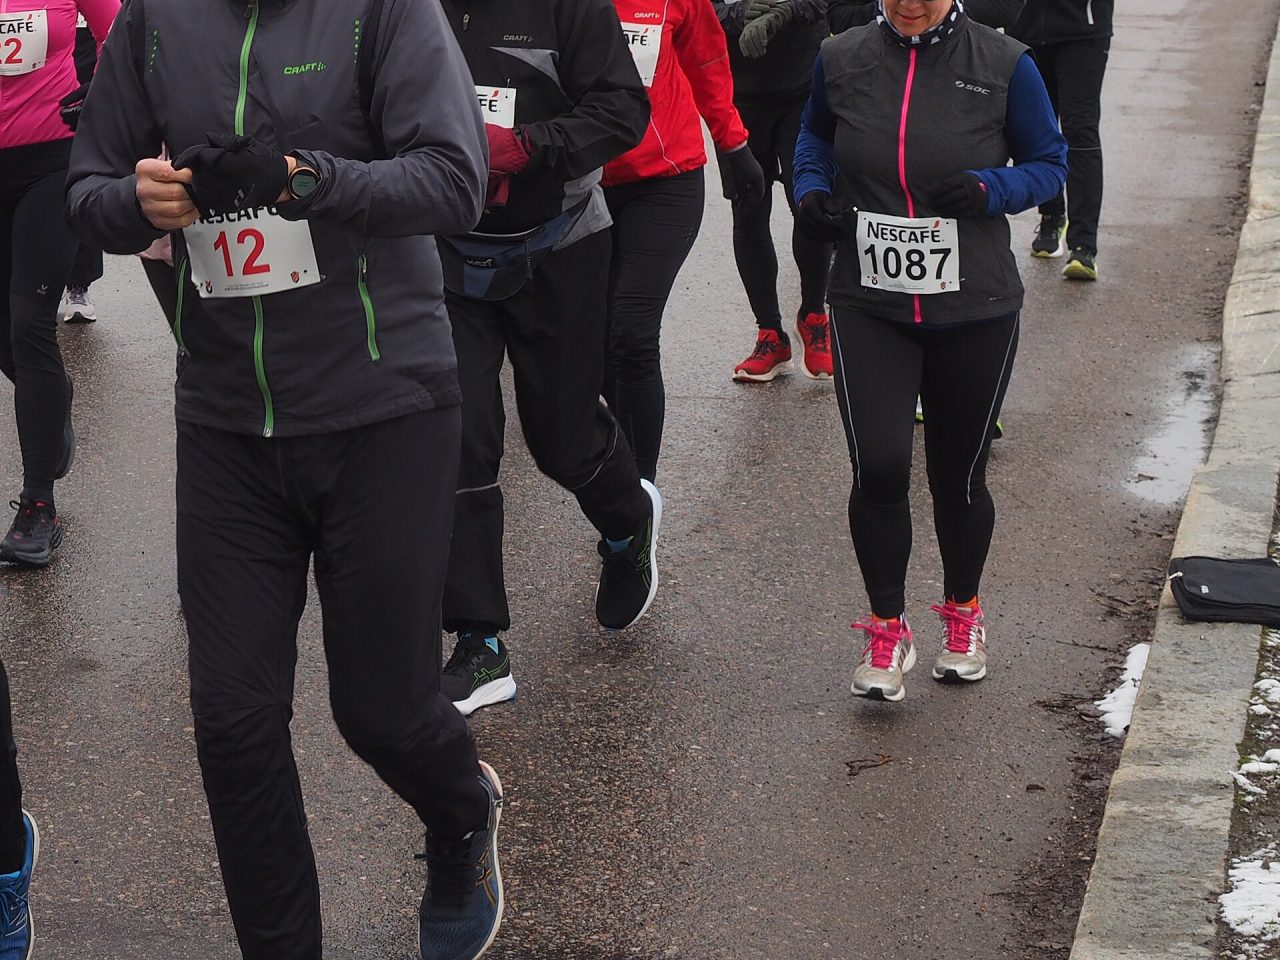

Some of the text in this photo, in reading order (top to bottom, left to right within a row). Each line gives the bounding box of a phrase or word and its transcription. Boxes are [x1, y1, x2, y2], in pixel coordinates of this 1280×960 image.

[283, 63, 317, 75] CRAFT
[867, 220, 940, 243] NESCAFÉ
[213, 227, 270, 277] 12
[864, 244, 952, 280] 1087
